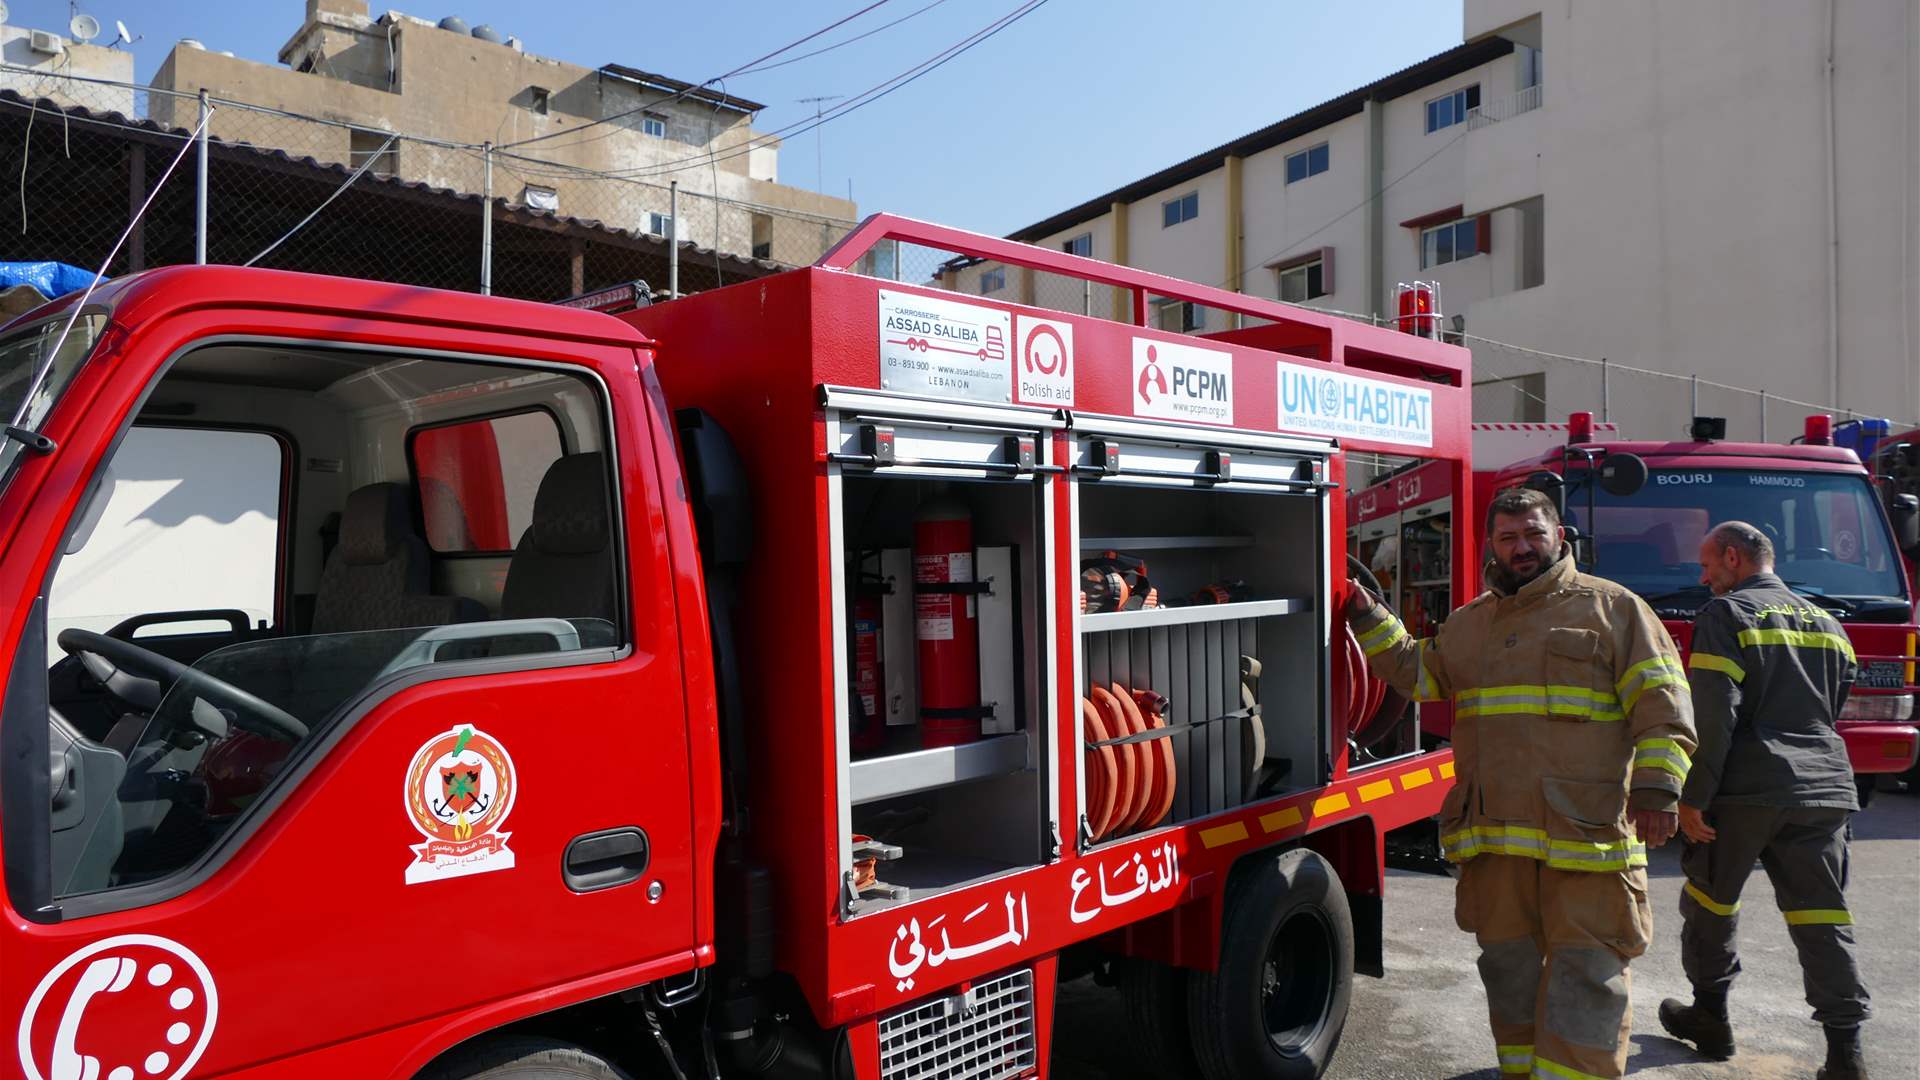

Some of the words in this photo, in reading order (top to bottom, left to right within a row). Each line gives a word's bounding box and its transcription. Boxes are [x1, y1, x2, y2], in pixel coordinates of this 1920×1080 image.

[895, 307, 941, 321] CARROSSERIE
[886, 316, 931, 334] ASSAD
[934, 324, 979, 342] SALIBA
[928, 376, 970, 389] LEBANON
[1022, 382, 1053, 399] Polish
[1055, 386, 1071, 400] aid
[1172, 366, 1228, 402] PCPM
[1282, 371, 1317, 415] UN
[1343, 382, 1430, 431] HABITAT
[1172, 402, 1228, 419] www.pcpm.org.pl
[1283, 416, 1307, 428] UNITED
[1308, 419, 1336, 431] NATIONS
[1656, 473, 1713, 486] BOURJ
[1750, 475, 1805, 488] HAMMOUD
